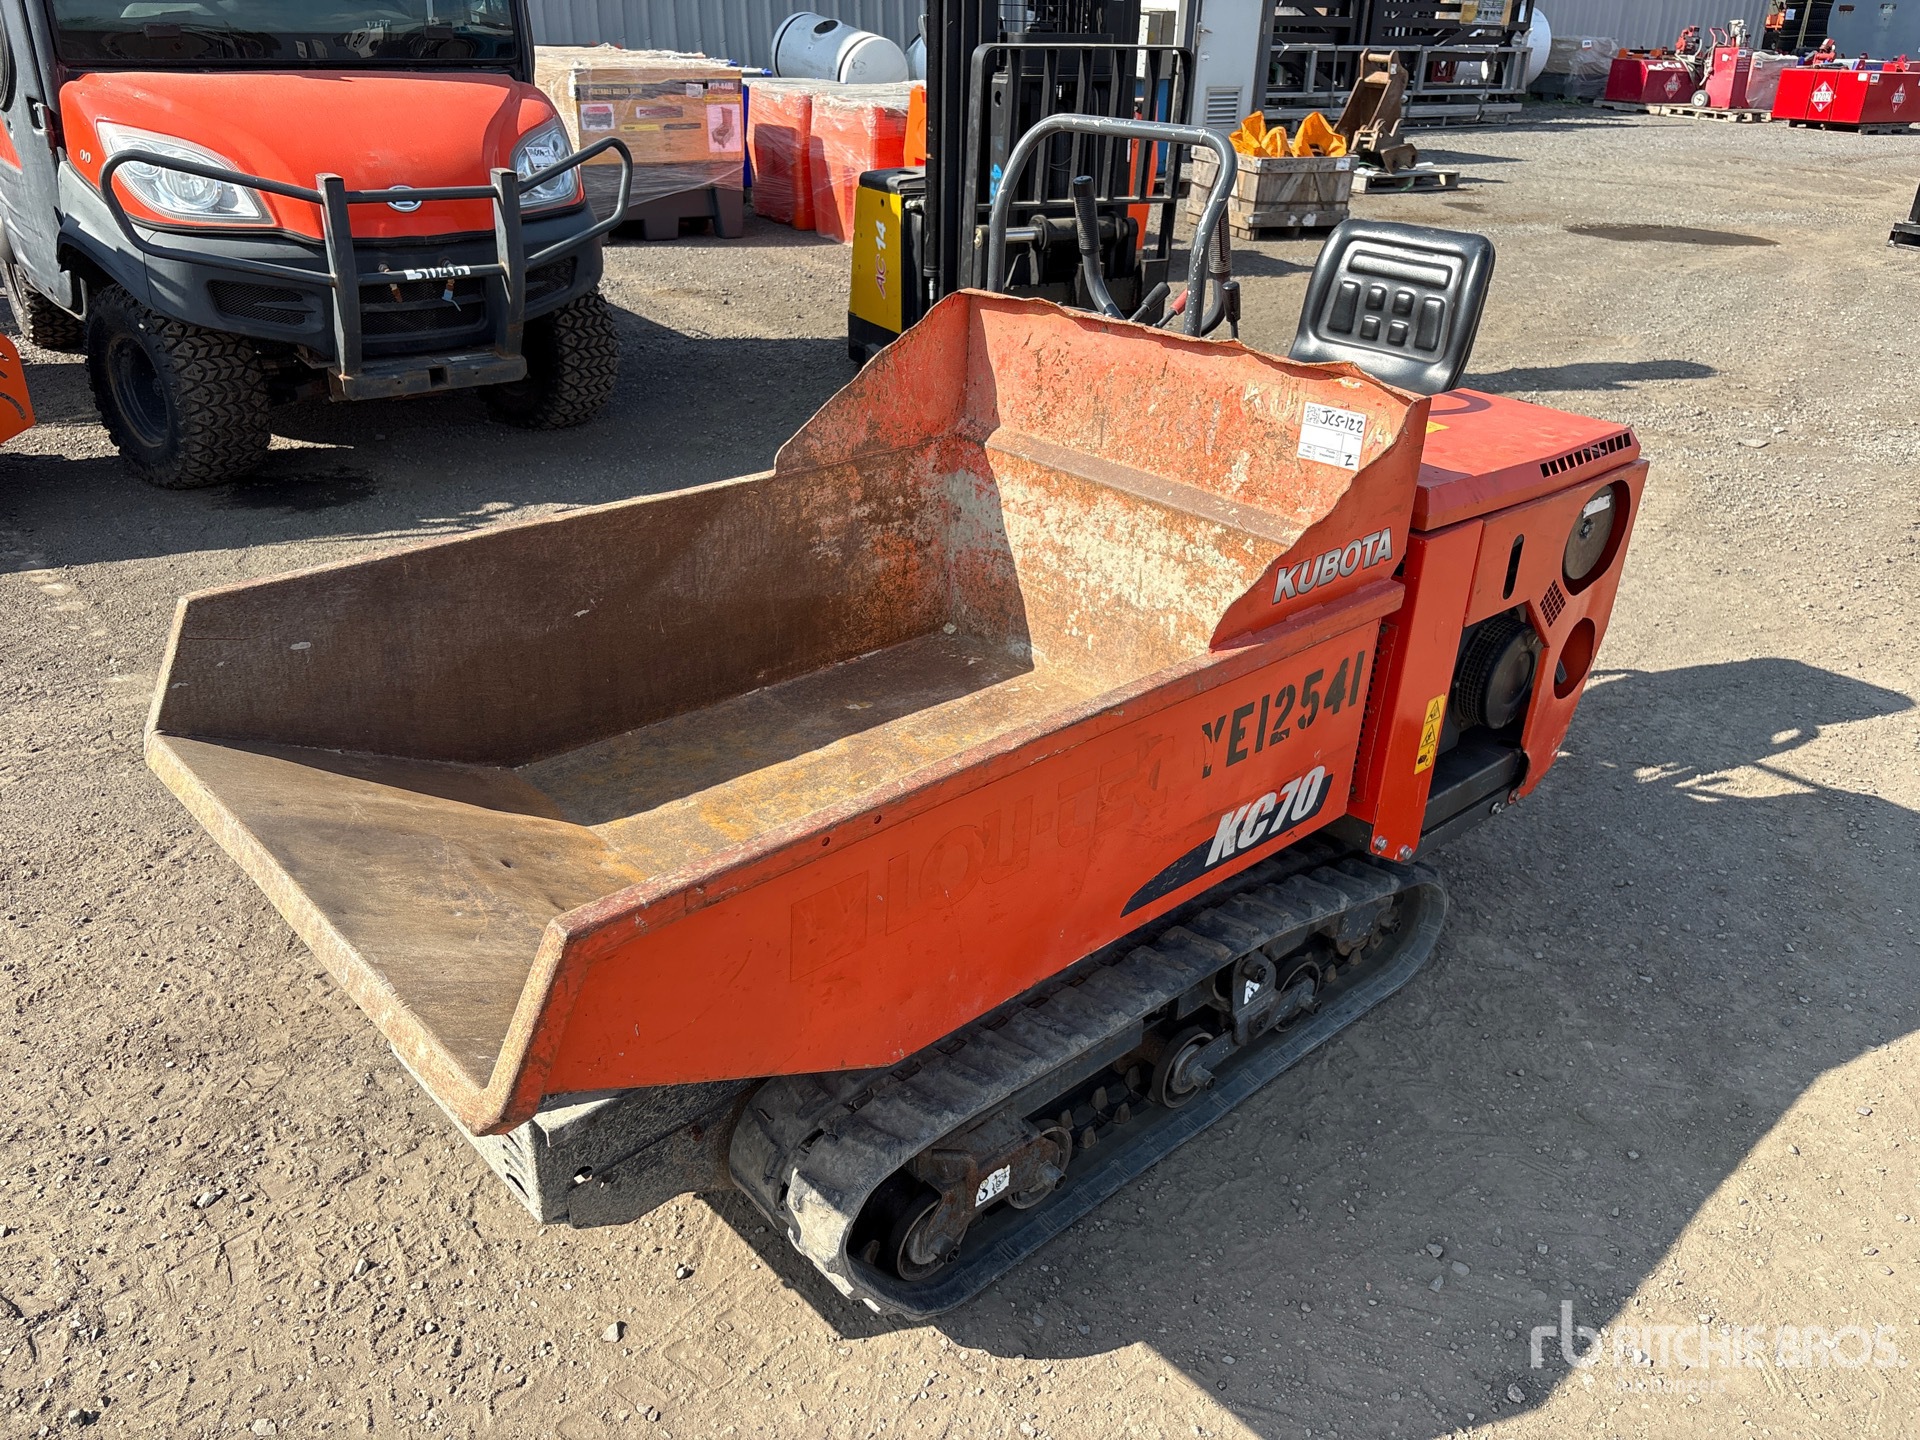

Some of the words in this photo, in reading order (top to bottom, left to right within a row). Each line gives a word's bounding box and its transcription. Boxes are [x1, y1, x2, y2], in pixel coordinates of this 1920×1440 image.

[875, 220, 886, 250] 14
[875, 253, 886, 300] AC
[1272, 527, 1392, 605] KUBOTA
[1204, 765, 1326, 867] KC70
